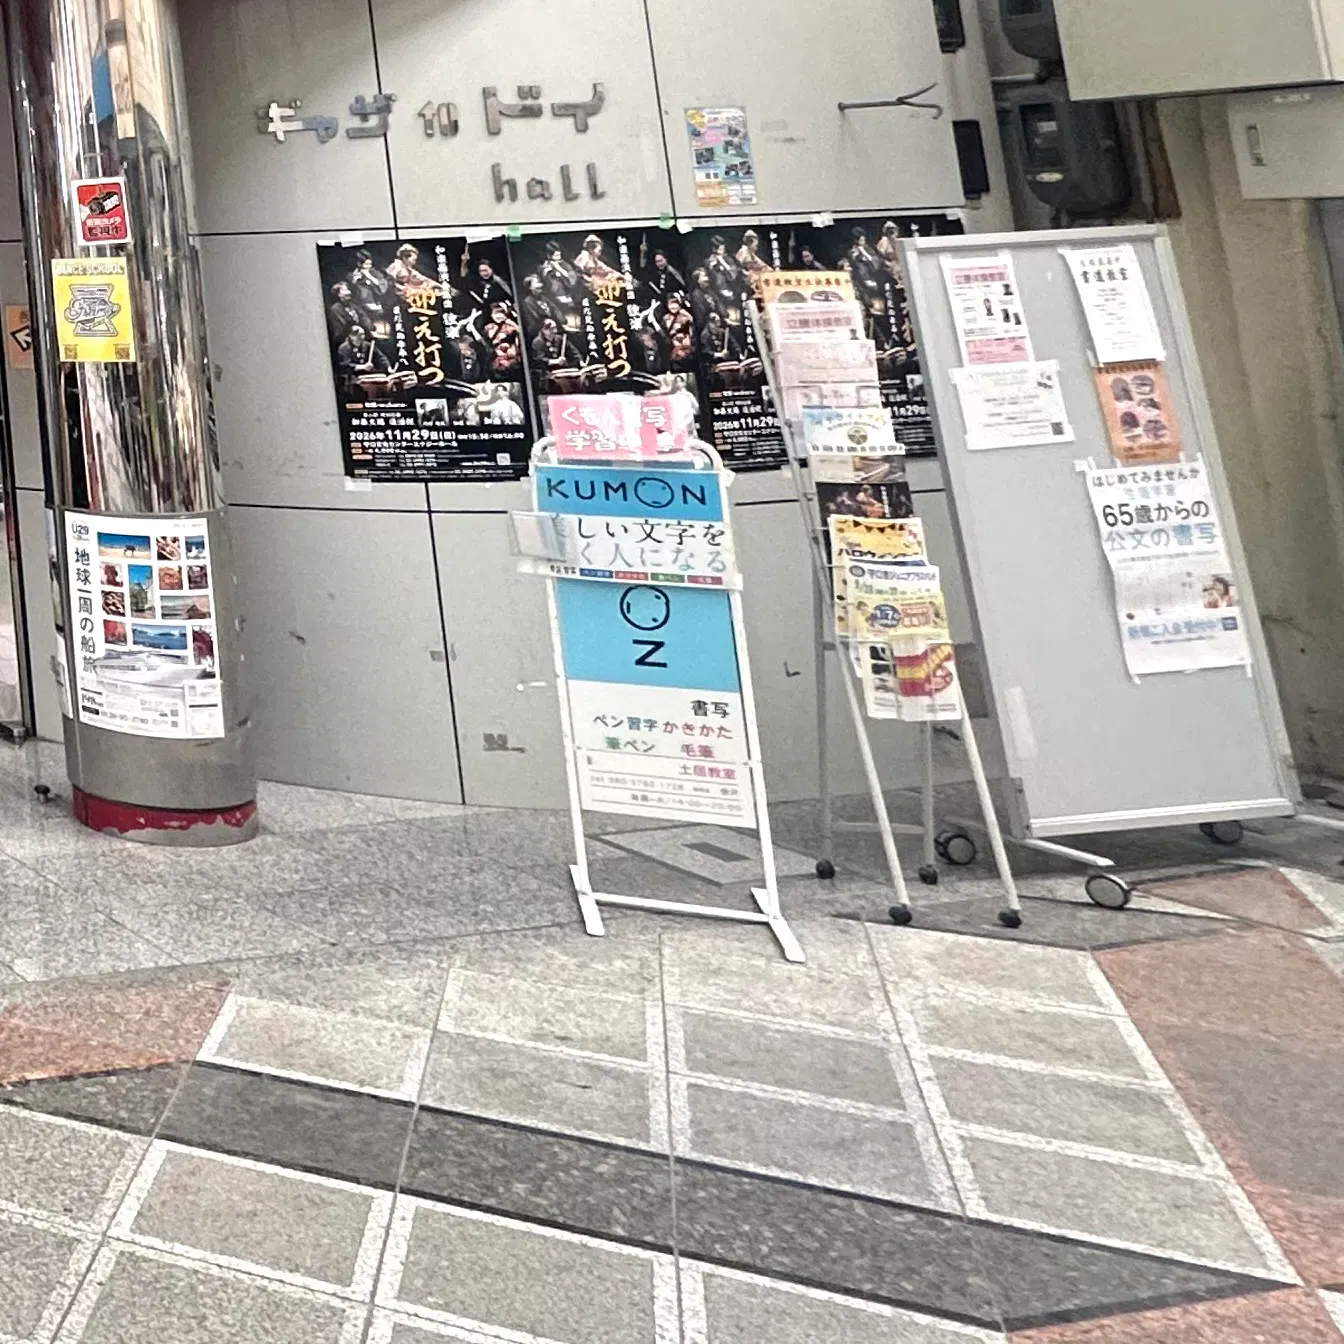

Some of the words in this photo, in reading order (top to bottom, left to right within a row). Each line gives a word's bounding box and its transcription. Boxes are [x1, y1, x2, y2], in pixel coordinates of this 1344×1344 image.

[481, 83, 607, 136] ドイ
[491, 162, 607, 203] hall
[545, 476, 707, 508] KUMON
[1102, 500, 1210, 527] 65歳からの
[1104, 522, 1218, 552] 公文の書写
[73, 546, 97, 674] 地球一周の船旅
[689, 699, 730, 719] 書写
[593, 714, 659, 732] ペン習字
[662, 720, 735, 740] かきかた
